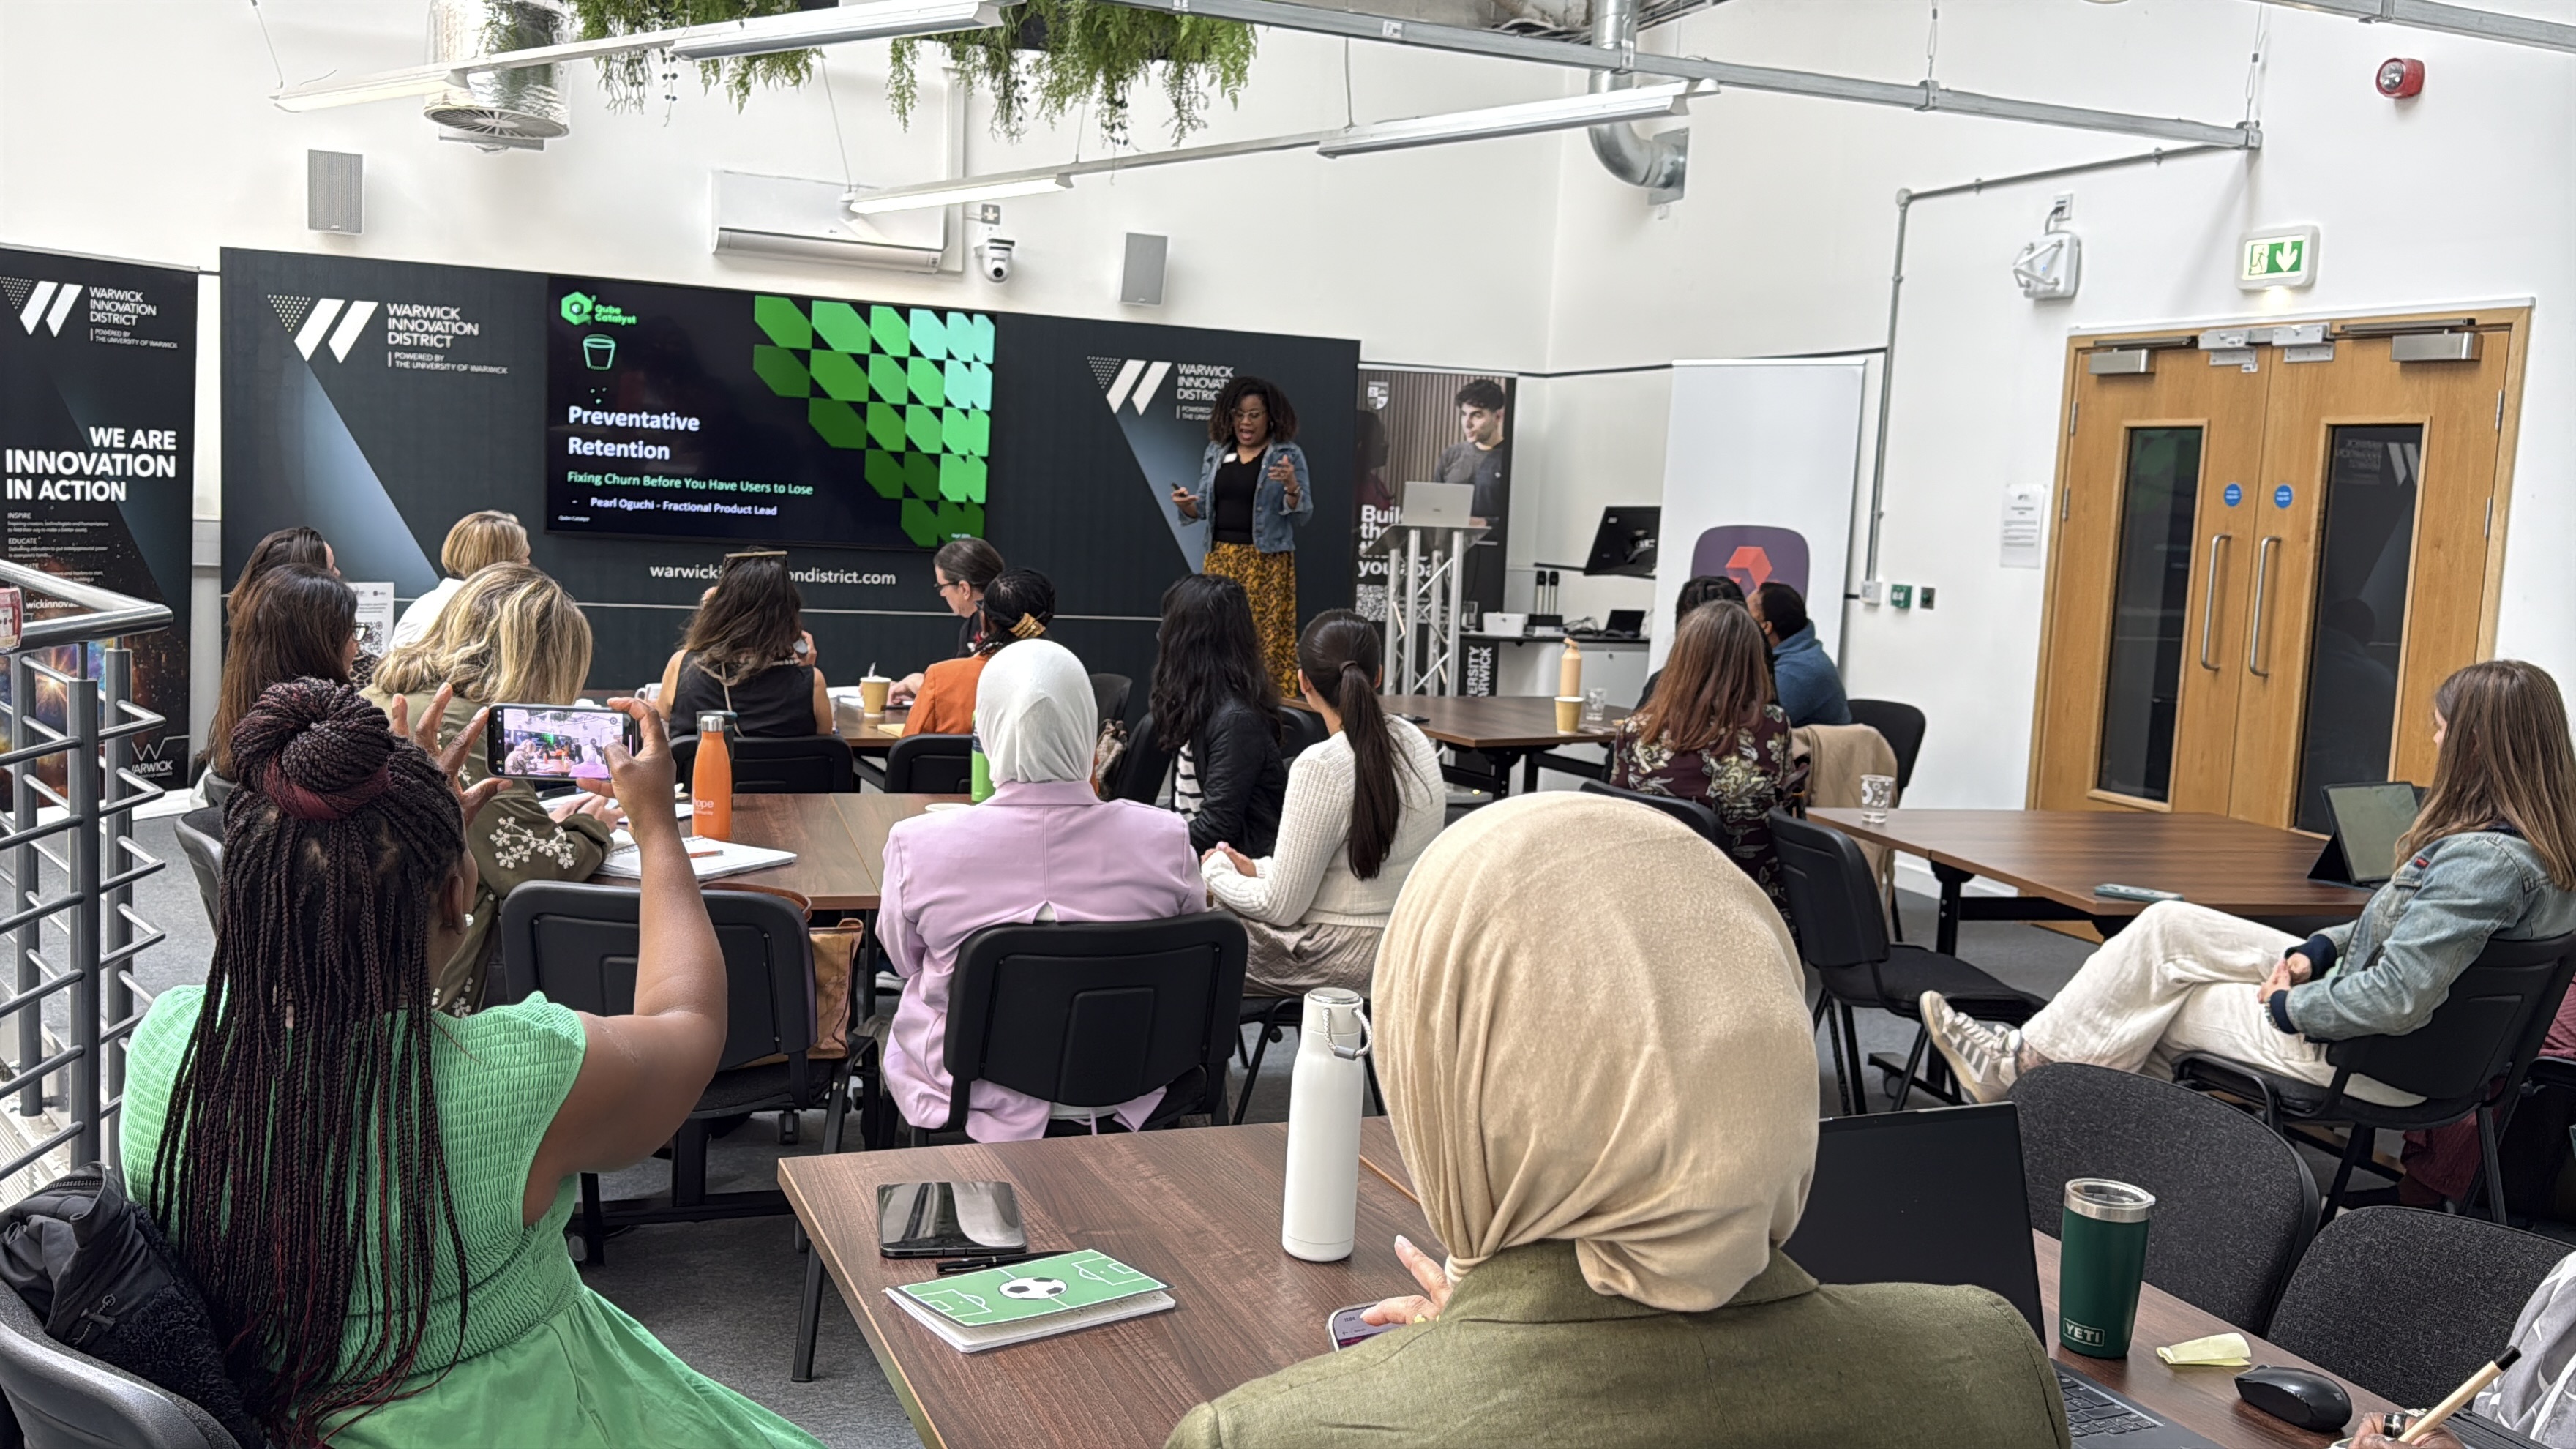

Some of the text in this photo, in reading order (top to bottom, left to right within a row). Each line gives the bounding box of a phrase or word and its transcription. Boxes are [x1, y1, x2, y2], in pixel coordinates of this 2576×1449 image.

[89, 286, 144, 303] WARWICK
[89, 299, 157, 317] INNOVATION
[386, 302, 461, 321] WARWICK
[89, 310, 139, 326] DISTRICT
[387, 317, 479, 337] INNOVATION
[594, 312, 637, 326] Catalyst
[94, 328, 122, 337] POWERED
[387, 331, 454, 348] DISTRICT
[107, 337, 139, 345] UNIVERSITY
[149, 340, 178, 349] WARWICK
[394, 351, 445, 362] POWERED BY
[394, 360, 509, 375] THE UNIVERSITY OF WARWICK
[1177, 362, 1235, 378] WARWICK
[1177, 375, 1230, 390] INNOVAT
[1177, 387, 1221, 402] DISTRIC
[568, 405, 700, 432] Preventative
[89, 426, 176, 450] WE ARE
[568, 436, 670, 460] Retention
[6, 449, 176, 478] INNOVATION
[7, 479, 127, 501] IN ACTION
[567, 471, 814, 495] Fixing Churn Before You Have Users to Lose
[590, 497, 617, 508] Pearl
[618, 498, 654, 511] Oguchi
[662, 501, 712, 513] Fractional
[714, 503, 752, 515] Product
[754, 505, 778, 516] Lead
[1361, 504, 1404, 524] Buil
[8, 537, 37, 545] EDUCATE
[1466, 645, 1480, 697] ERSITY
[1478, 646, 1493, 697] ARWICK
[132, 760, 173, 774] ARWICK
[2066, 1322, 2100, 1343] YETI
